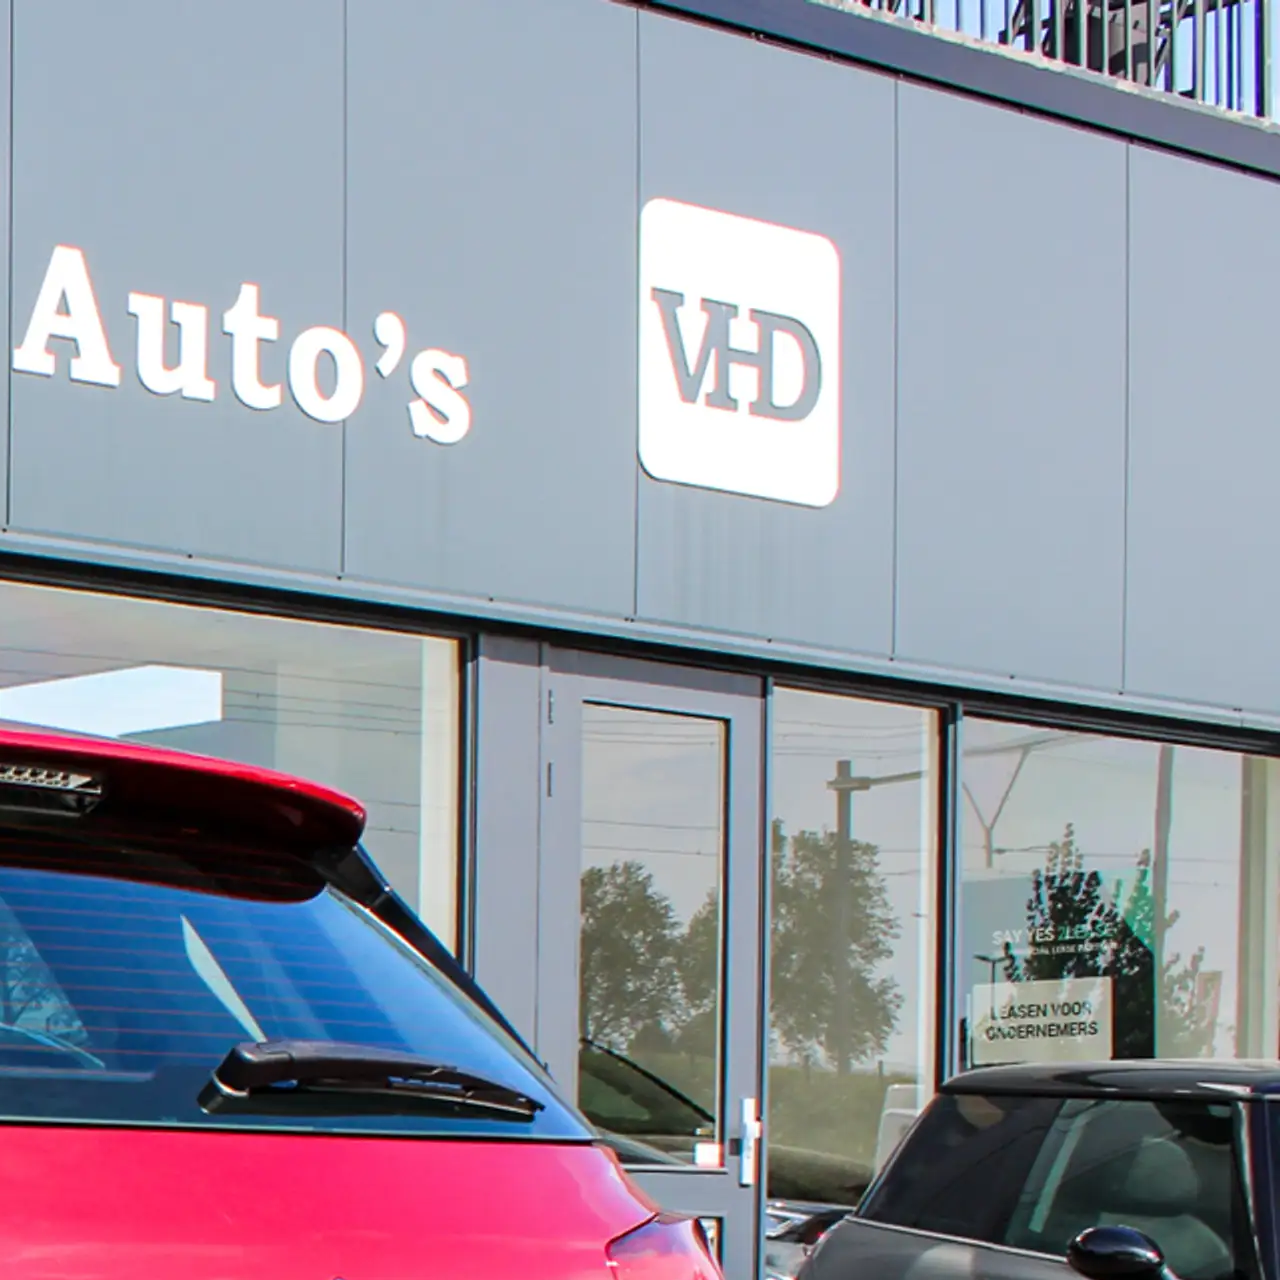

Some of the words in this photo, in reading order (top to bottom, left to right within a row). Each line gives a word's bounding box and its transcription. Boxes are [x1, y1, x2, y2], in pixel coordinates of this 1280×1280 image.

[11, 244, 472, 446] Auto's
[650, 286, 824, 423] VHD
[985, 1021, 1099, 1041] ONDERNEMERS
[990, 1003, 1048, 1020] LEASEN
[1050, 1000, 1092, 1017] VOOR
